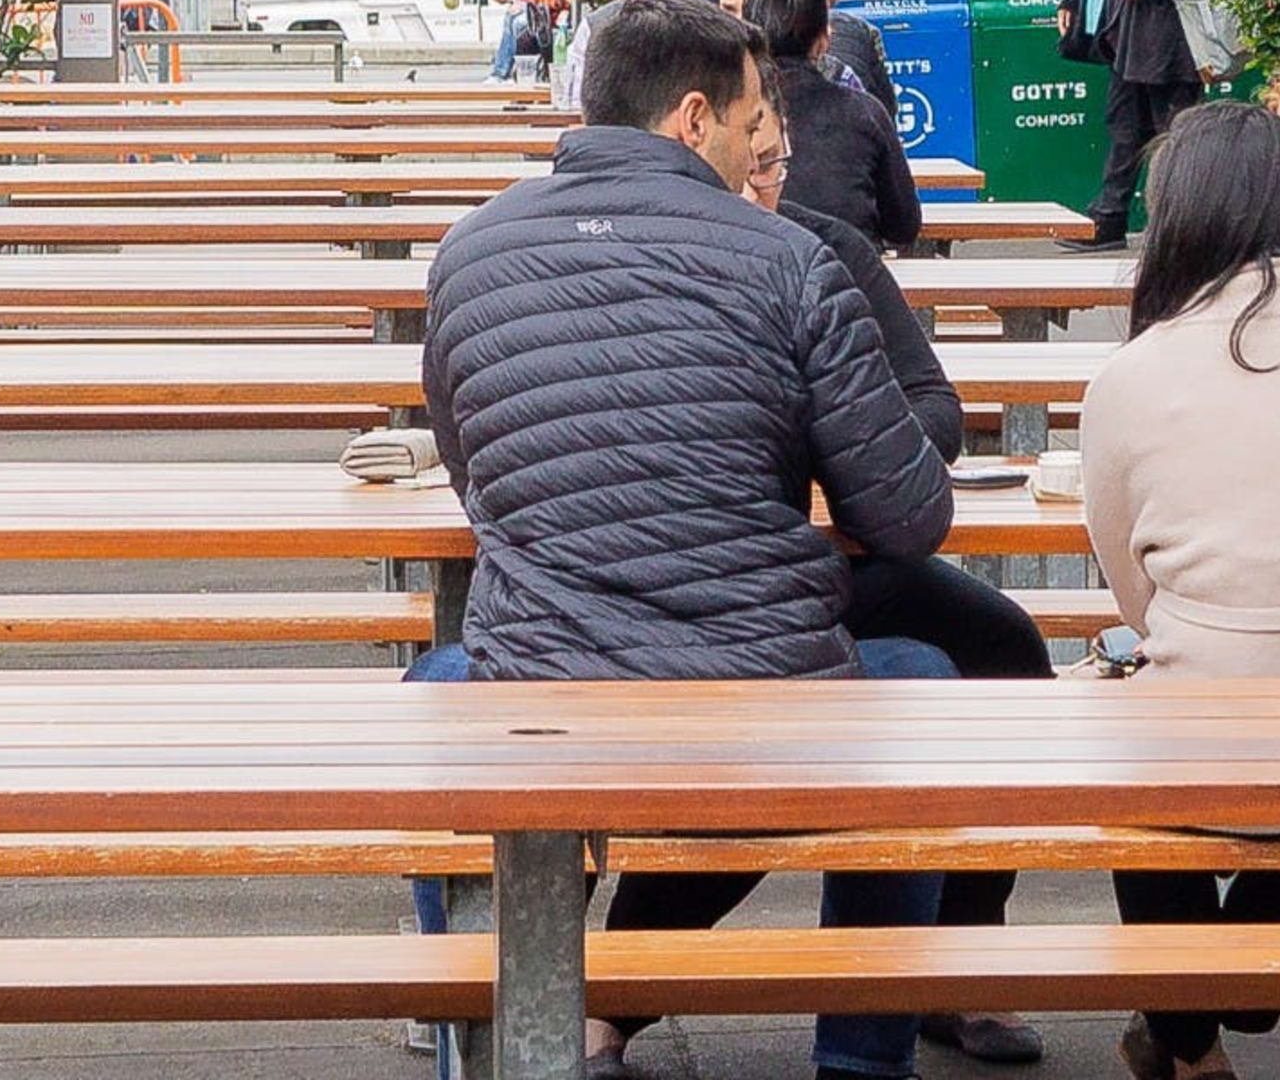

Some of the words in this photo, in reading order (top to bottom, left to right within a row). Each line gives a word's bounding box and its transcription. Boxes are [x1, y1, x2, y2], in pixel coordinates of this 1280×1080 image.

[883, 59, 932, 75] OTT'S
[1011, 82, 1087, 101] GOTT'S
[1015, 112, 1086, 128] COMPOST
